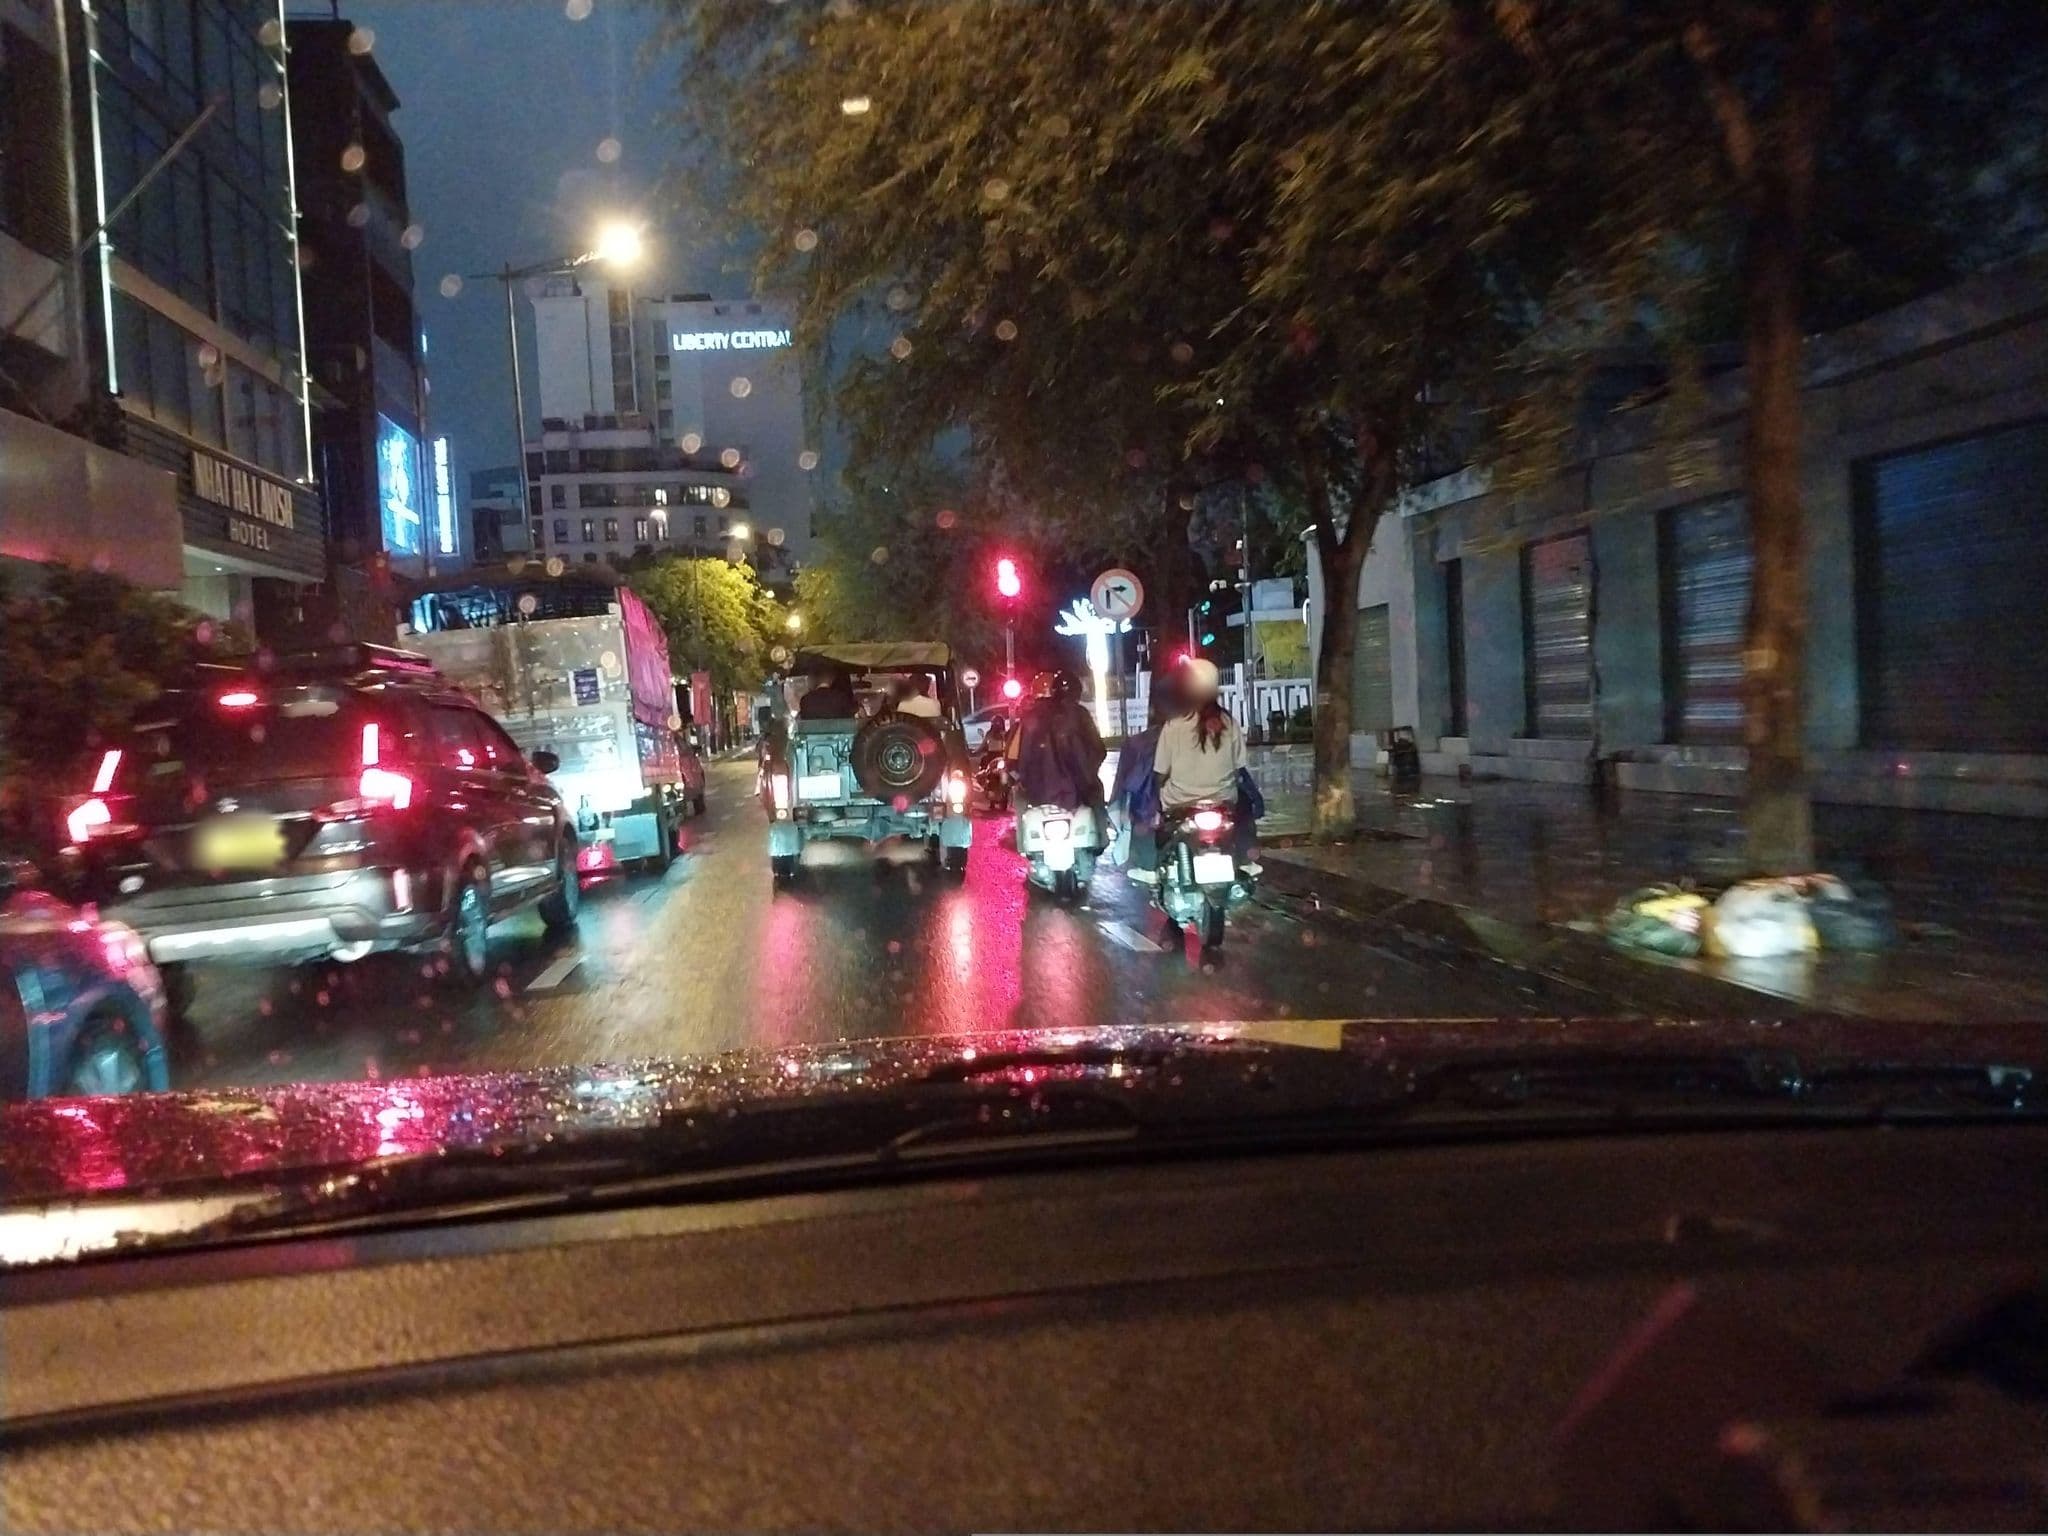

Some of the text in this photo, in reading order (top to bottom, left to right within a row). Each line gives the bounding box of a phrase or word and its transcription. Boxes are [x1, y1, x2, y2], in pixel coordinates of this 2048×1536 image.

[673, 330, 792, 350] LIBERTY CENTRAL
[230, 518, 270, 551] HOTEL
